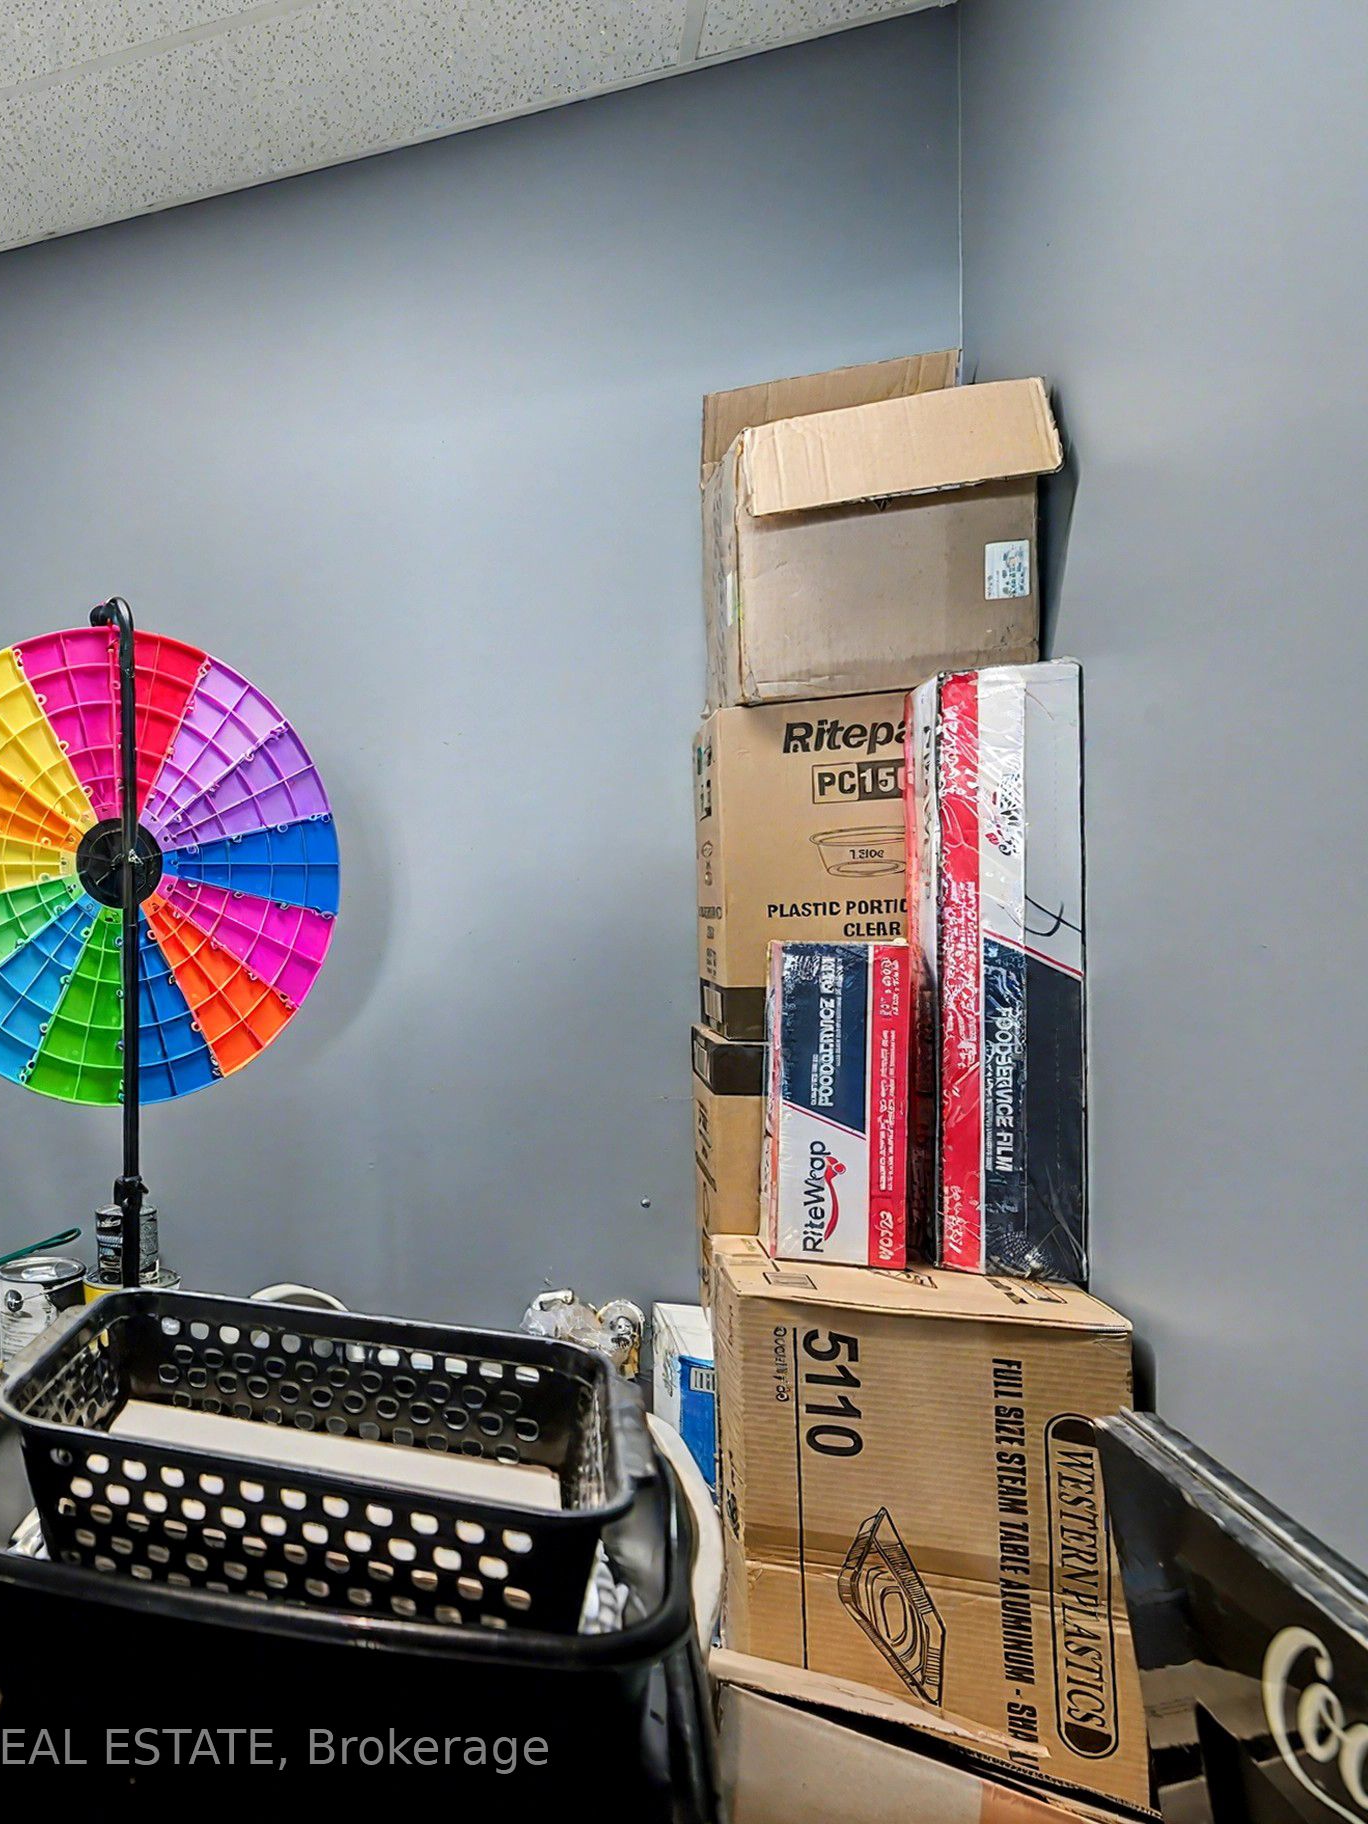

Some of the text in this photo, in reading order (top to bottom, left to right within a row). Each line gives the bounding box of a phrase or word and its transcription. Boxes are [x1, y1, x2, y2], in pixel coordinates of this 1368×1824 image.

[767, 901, 842, 919] PLASTIC
[843, 921, 902, 937] CLEAR
[994, 1131, 1014, 1172] FILM
[801, 1139, 827, 1253] RiteWrap
[802, 1328, 864, 1458] 5110
[992, 1358, 1022, 1398] FULL
[993, 1406, 1026, 1446] SIZE
[995, 1451, 1030, 1515] STEAM
[998, 1521, 1031, 1575] TABLE
[1055, 1447, 1107, 1729] WESTERN PLASTICS
[1000, 1578, 1036, 1686] ALUMINUM
